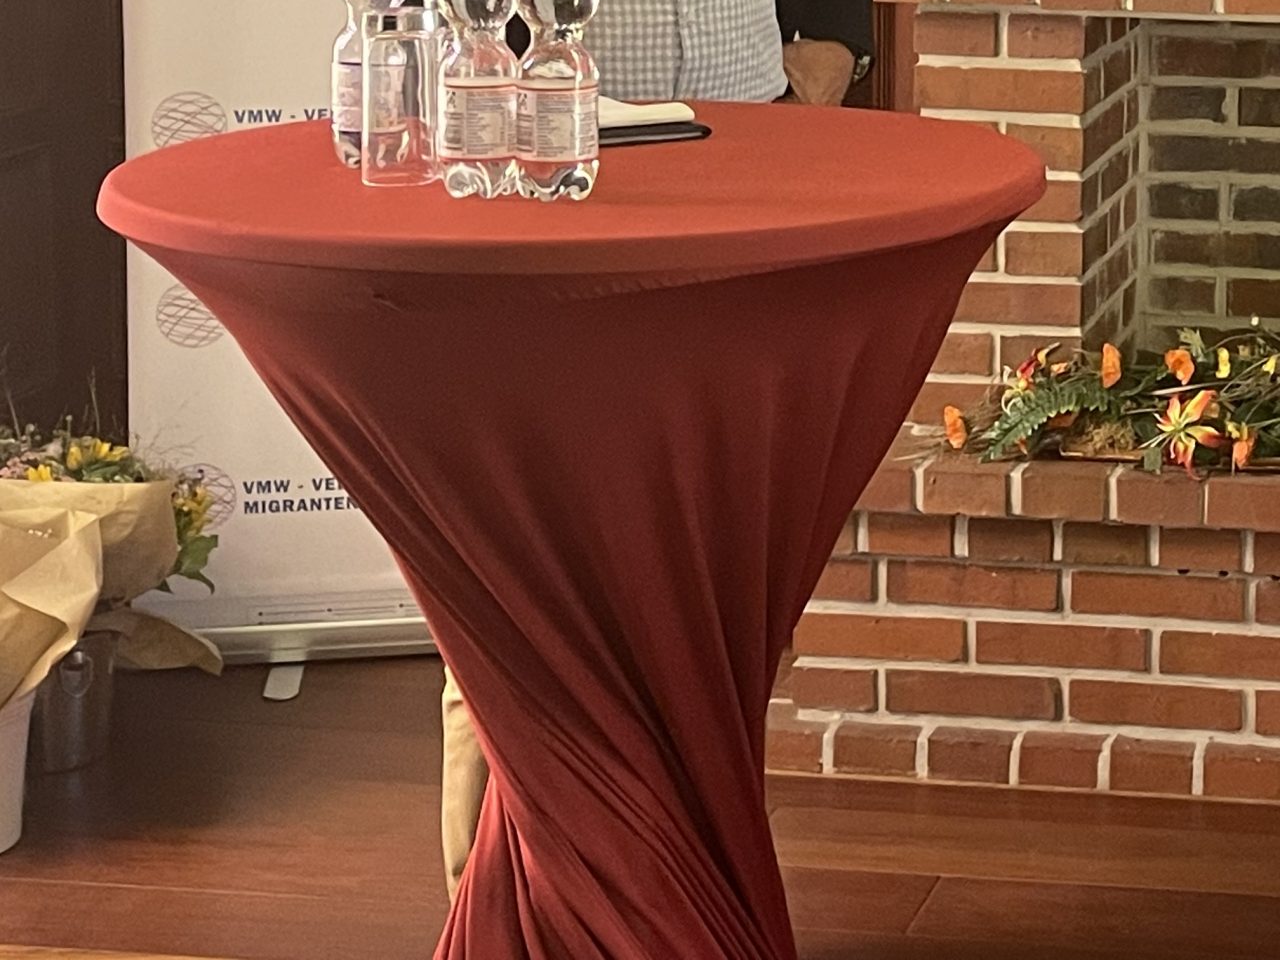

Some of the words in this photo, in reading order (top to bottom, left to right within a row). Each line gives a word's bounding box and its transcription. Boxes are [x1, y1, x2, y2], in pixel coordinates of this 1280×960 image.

[234, 109, 282, 123] VMW
[304, 108, 333, 121] VE
[243, 479, 291, 494] VMW
